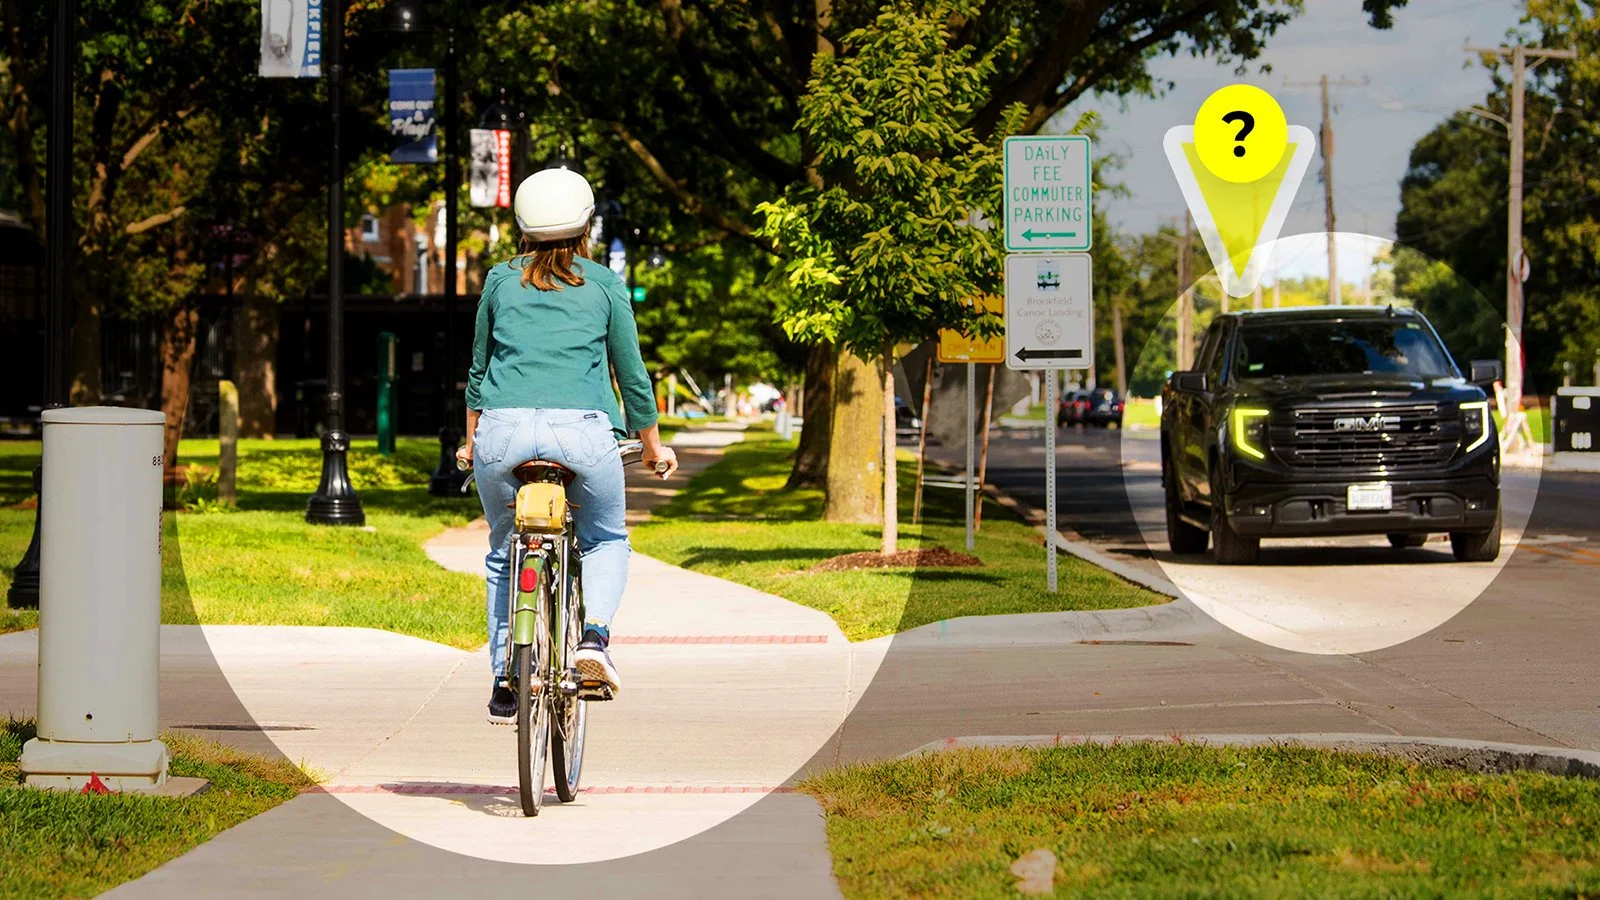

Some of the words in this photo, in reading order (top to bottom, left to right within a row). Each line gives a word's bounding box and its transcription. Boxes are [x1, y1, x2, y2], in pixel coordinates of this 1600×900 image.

[1024, 145, 1069, 161] DAILY
[1033, 166, 1062, 181] FEE
[1013, 186, 1083, 202] COMMUTER
[1014, 207, 1082, 222] PARKING
[1027, 296, 1073, 306] Brookfield
[1016, 308, 1046, 317] Canoe
[1048, 308, 1083, 319] Landing
[1334, 416, 1400, 432] GMC
